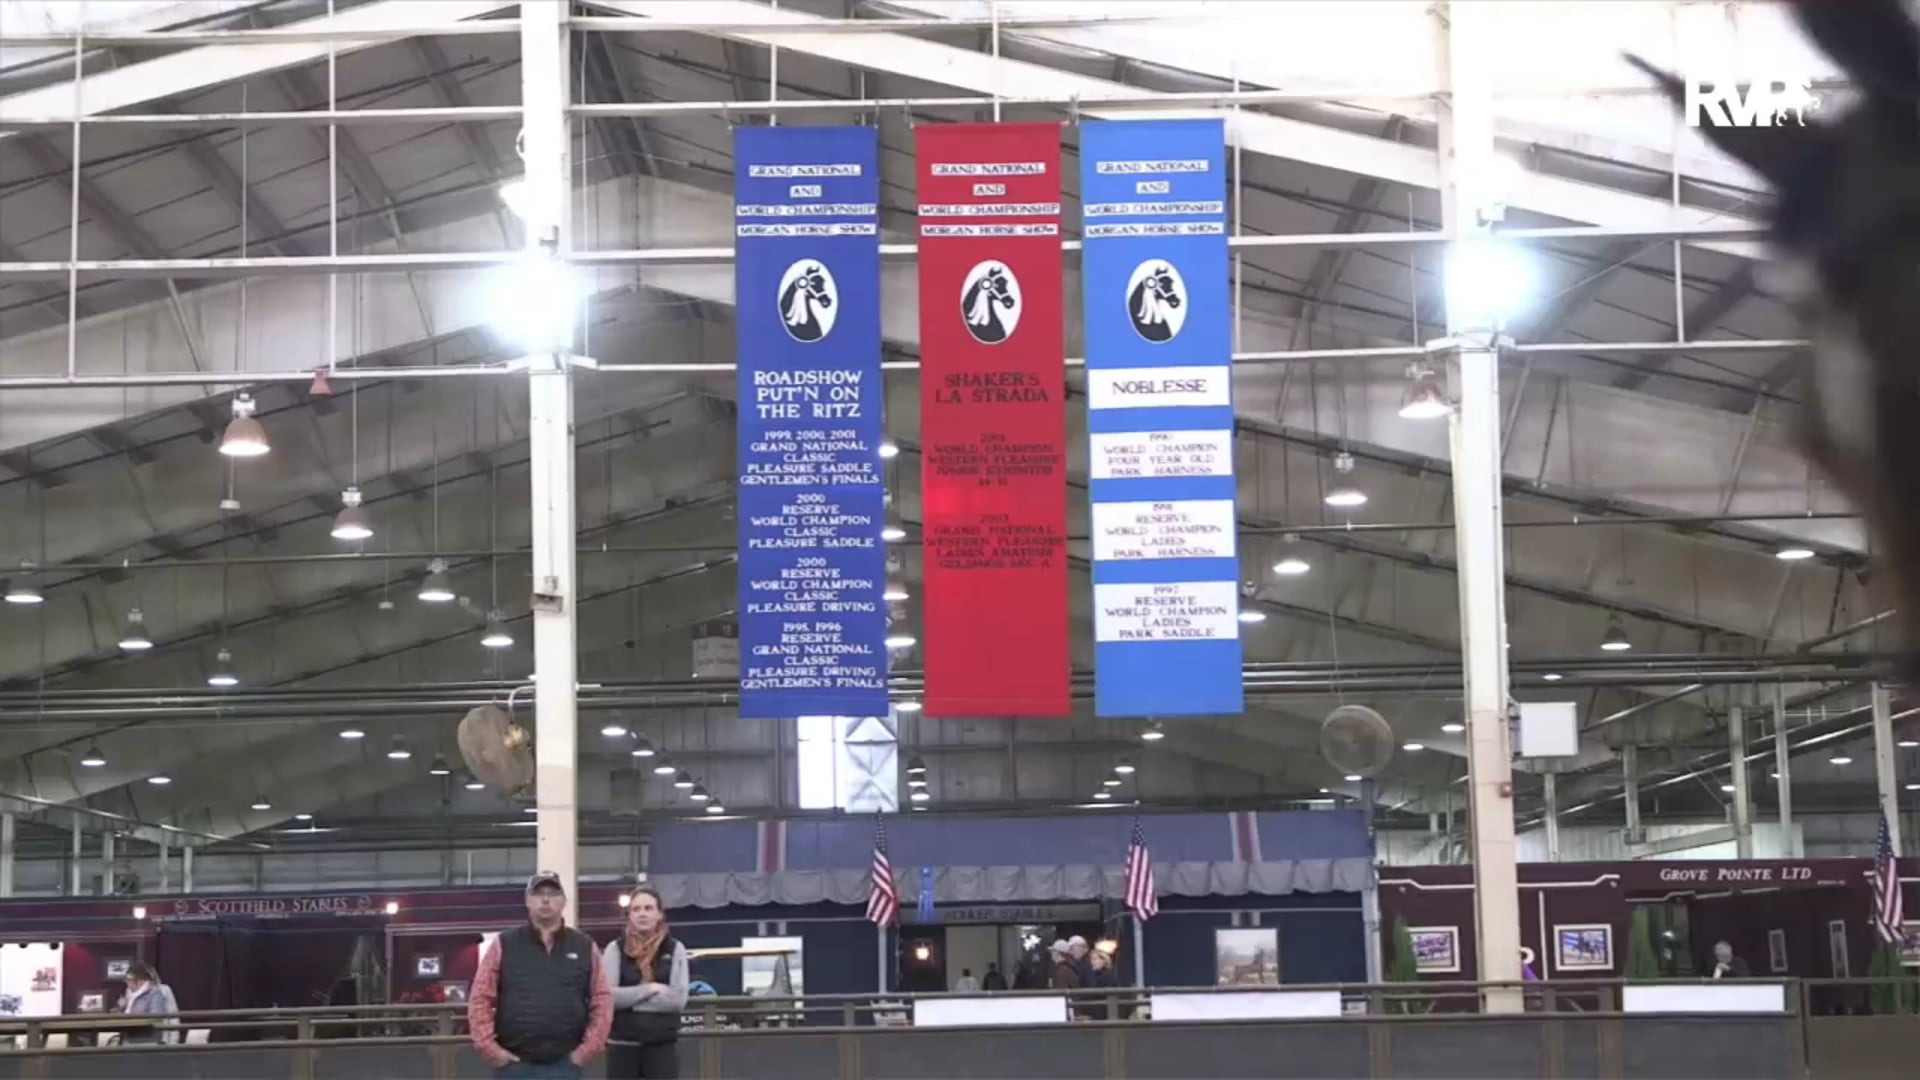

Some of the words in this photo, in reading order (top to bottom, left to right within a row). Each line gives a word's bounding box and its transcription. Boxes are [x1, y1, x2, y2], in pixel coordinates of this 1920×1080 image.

[794, 187, 821, 196] AND
[976, 185, 1004, 194] AND
[1141, 183, 1166, 192] AND
[739, 206, 782, 215] WORLD
[920, 205, 963, 214] WORLD
[1088, 205, 1129, 214] WORLD
[754, 370, 862, 385] ROADSHOW
[1112, 379, 1207, 395] NOBLESSE
[757, 386, 819, 401] PUT'N
[830, 386, 859, 400] ON
[935, 389, 961, 403] LA
[972, 388, 1049, 402] STRADA
[757, 403, 800, 418] THE
[812, 403, 861, 417] RITZ
[751, 442, 797, 452] GRAND
[803, 441, 868, 451] NATIONAL
[1104, 445, 1146, 454] WORLD
[1155, 444, 1218, 453] CHAMPION
[783, 453, 836, 463] CLASSIC
[1108, 456, 1140, 465] FOUR
[1149, 456, 1182, 464] YEAR
[1190, 455, 1214, 463] OLD
[747, 464, 815, 474] PLEASURE
[821, 463, 872, 472] SADDLE
[1111, 468, 1142, 476] PARK
[1154, 467, 1212, 475] HARNESS
[832, 474, 879, 484] FINALS
[796, 494, 825, 503] 2000
[782, 505, 840, 515] RESERVE
[751, 516, 797, 526] WORLD
[802, 516, 871, 525] CHAMPION
[1136, 515, 1190, 523] RESERVE
[784, 527, 837, 537] CLASSIC
[1105, 527, 1148, 536] WORLD
[1159, 525, 1222, 534] CHAMPION
[749, 538, 817, 548] PLEASURE
[823, 538, 874, 547] SADDLE
[1142, 537, 1185, 546] LADIES
[1114, 550, 1144, 558] PARK
[1158, 549, 1215, 557] HARNESS
[796, 558, 826, 567] 2000
[781, 569, 840, 578] RESERVE
[751, 581, 797, 590] WORLD
[802, 580, 872, 589] CHAMPION
[784, 591, 839, 601] CLASSIC
[1135, 597, 1196, 606] RESERVE
[747, 602, 816, 613] PLEASURE
[822, 602, 876, 612] DRIVING
[1105, 608, 1151, 617] WORLD
[1159, 606, 1227, 616] CHAMPION
[815, 622, 842, 631] 1996
[1142, 618, 1191, 627] LADIES
[781, 633, 842, 643] RESERVE
[1119, 629, 1153, 638] PARK
[1163, 628, 1215, 637] SADDLE
[752, 645, 799, 655] GRAND
[804, 645, 872, 654] NATIONAL
[784, 656, 840, 665] CLASSIC
[748, 668, 817, 678] PLEASURE
[823, 667, 876, 677] DRIVING
[740, 678, 832, 689] GENTLEMEN'S
[836, 678, 884, 688] FINALS
[1660, 868, 1708, 881] GROVE
[1717, 868, 1772, 880] POINTE
[1782, 867, 1812, 879] LTD
[200, 899, 285, 914] SCOTTFIELD
[294, 897, 348, 912] STABLES
